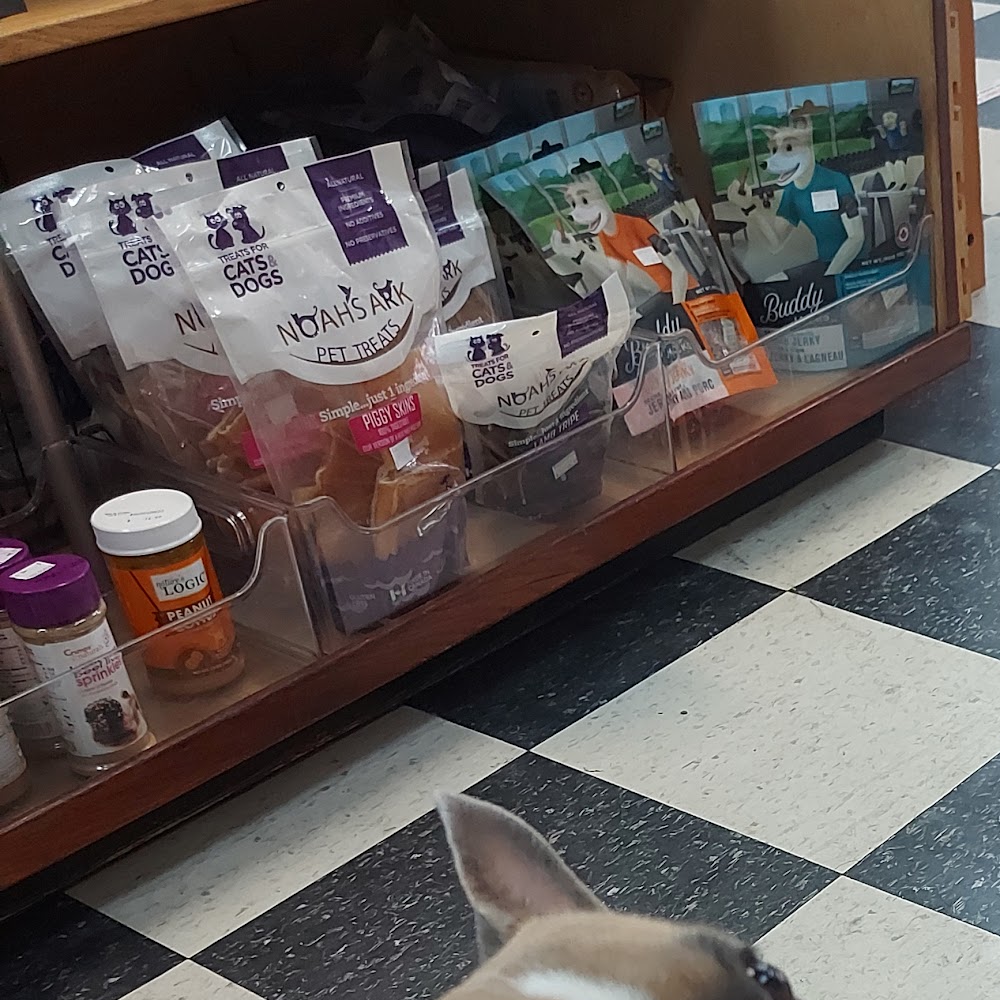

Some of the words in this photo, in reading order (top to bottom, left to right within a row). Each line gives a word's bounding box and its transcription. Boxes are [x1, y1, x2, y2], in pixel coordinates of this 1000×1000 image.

[236, 174, 248, 183] ALL
[247, 168, 276, 180] NATURAL
[356, 211, 384, 226] ADDITIVES
[344, 240, 355, 248] NO
[355, 226, 398, 244] PRESERVATIVES
[217, 248, 251, 264] TREATS
[251, 242, 269, 255] FOR
[223, 254, 268, 281] CATS
[229, 269, 284, 299] DOGS
[369, 280, 413, 316] ARK
[760, 282, 824, 324] Buddy
[316, 346, 346, 363] PET
[352, 319, 400, 359] TREATS
[471, 359, 496, 369] TREATS
[495, 354, 509, 364] FOR
[472, 363, 506, 379] CATS
[474, 372, 515, 388] DOGS
[362, 405, 393, 431] PIGGY
[392, 395, 416, 419] SKINS
[556, 410, 580, 433] TRIPE
[163, 571, 206, 596] LOGIC
[166, 595, 213, 621] PEANUT
